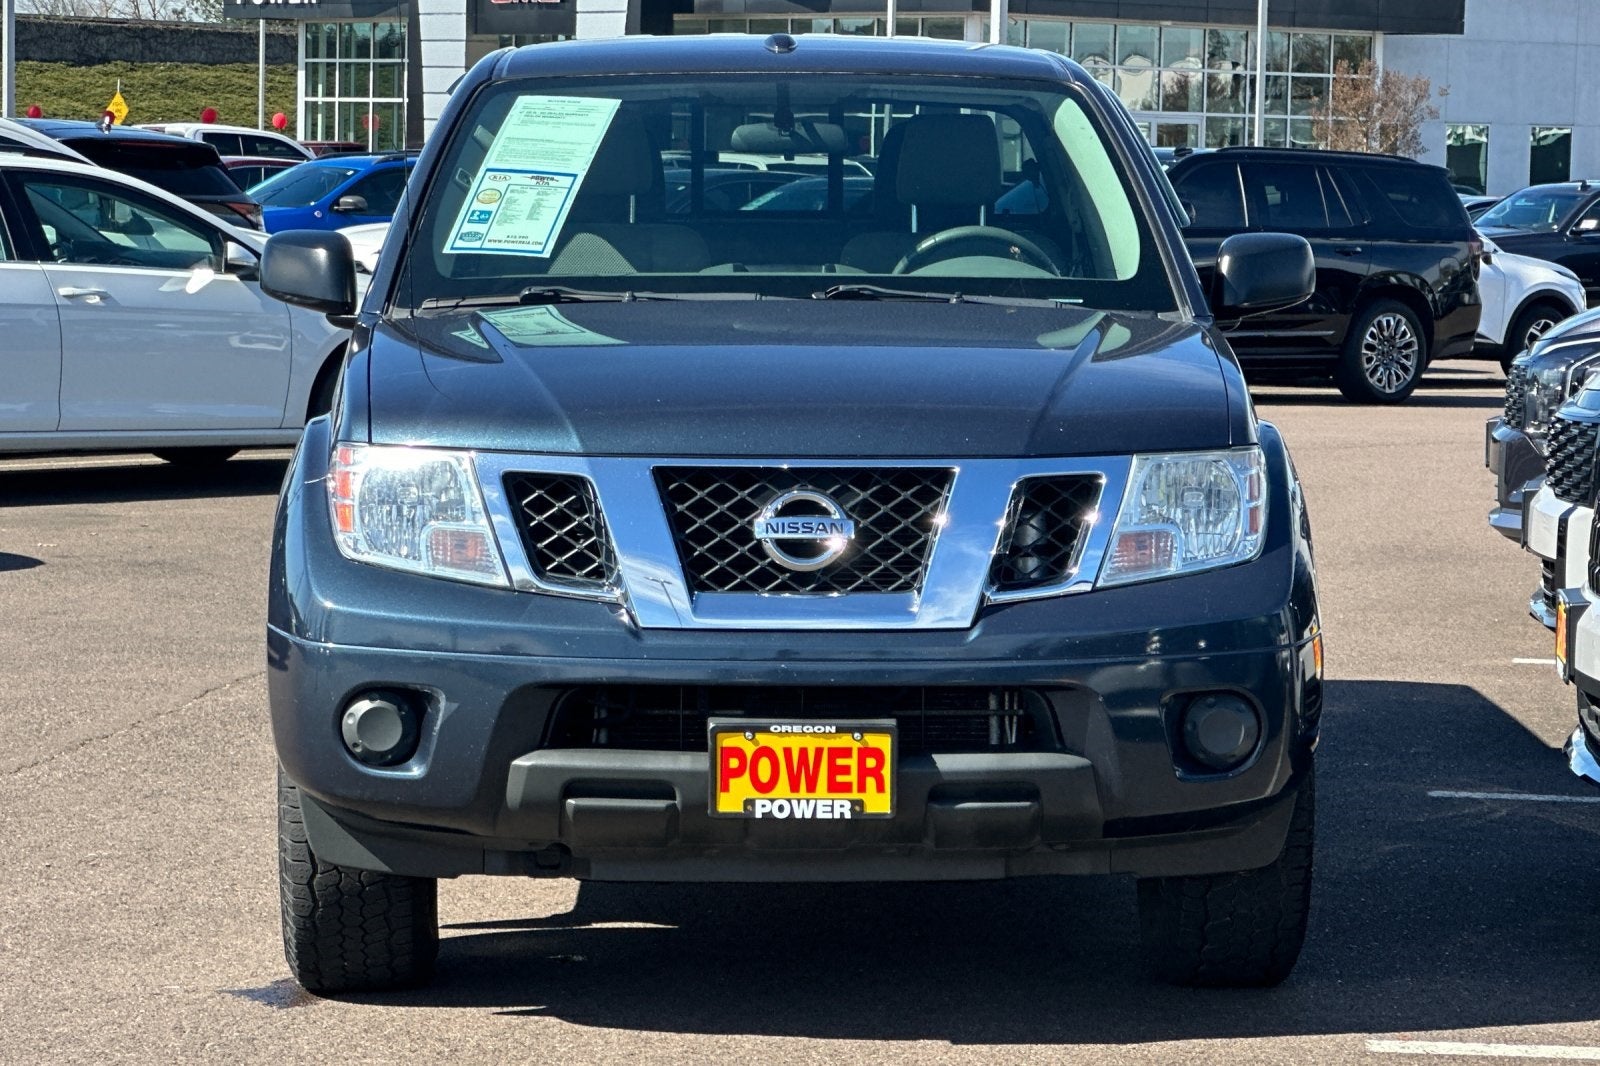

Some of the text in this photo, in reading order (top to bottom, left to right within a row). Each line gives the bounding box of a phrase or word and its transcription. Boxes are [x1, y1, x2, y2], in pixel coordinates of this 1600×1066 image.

[765, 522, 843, 534] NISSAN
[769, 725, 837, 733] OREGON
[720, 745, 886, 794] POWER
[755, 799, 851, 819] POWER
